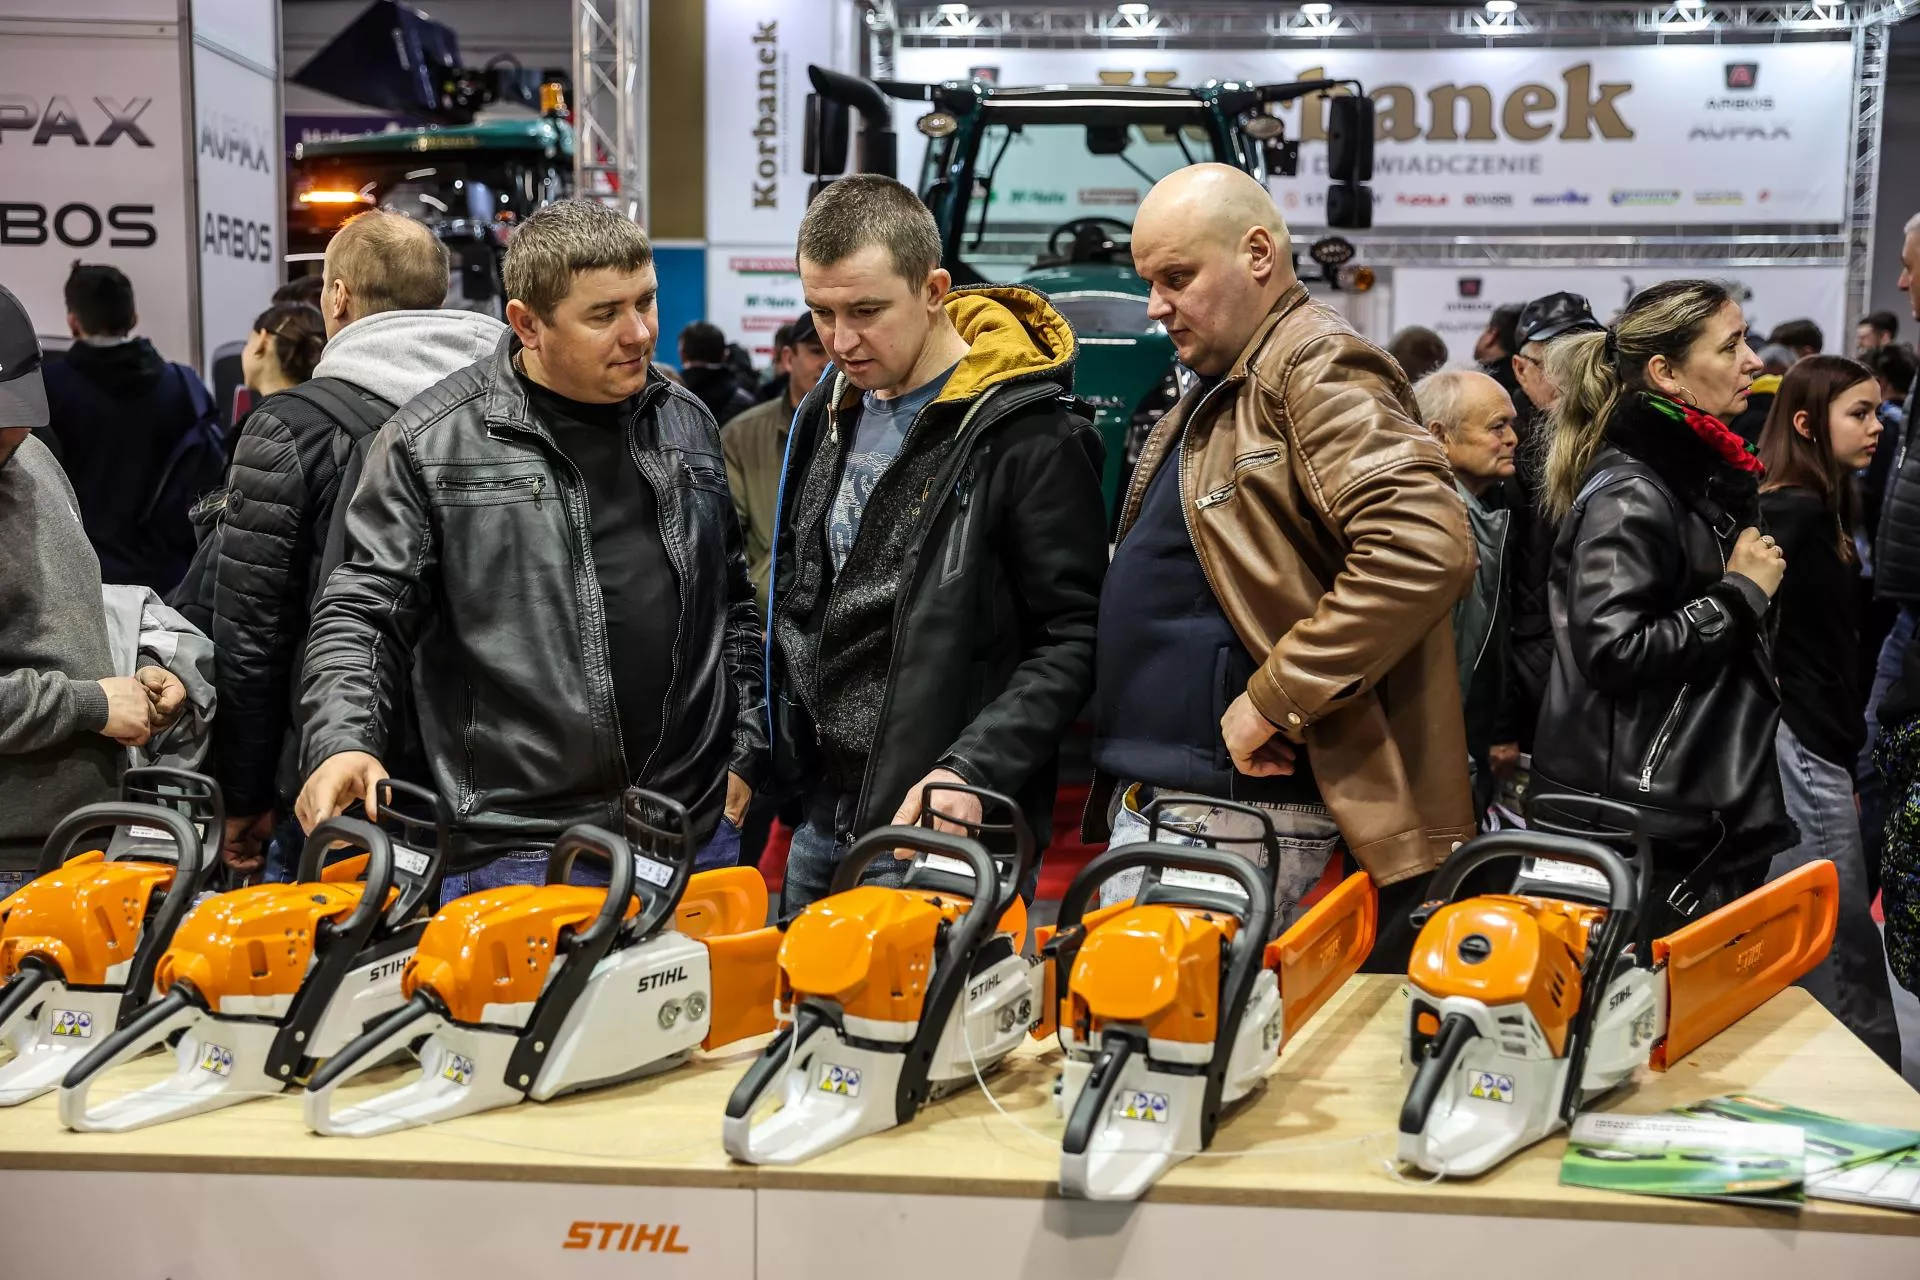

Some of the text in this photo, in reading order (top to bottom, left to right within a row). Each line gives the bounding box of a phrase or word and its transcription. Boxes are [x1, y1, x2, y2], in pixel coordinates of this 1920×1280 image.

[752, 20, 778, 209] Korbanek
[1313, 153, 1543, 176] DWIADCZENIE
[203, 210, 273, 263] ARBOS
[370, 956, 411, 982] STIH
[637, 966, 688, 993] STIHL
[970, 973, 1002, 1001] STIHL
[1609, 984, 1632, 1010] STIHL
[562, 1221, 690, 1253] STIHL
